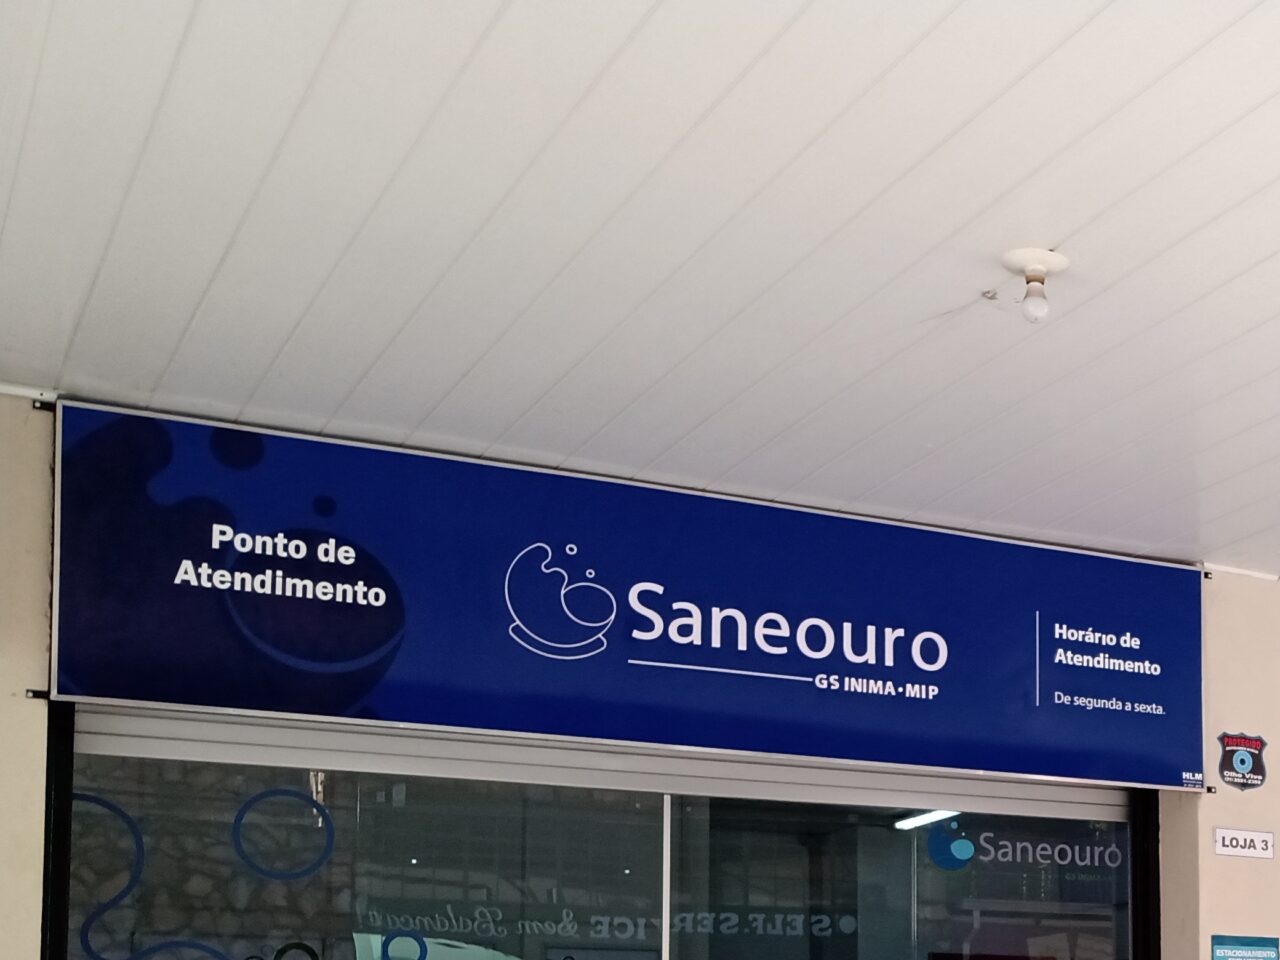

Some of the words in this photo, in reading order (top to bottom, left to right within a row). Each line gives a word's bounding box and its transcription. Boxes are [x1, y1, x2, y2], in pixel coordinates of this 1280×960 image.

[211, 523, 307, 559] Ponto
[317, 538, 356, 565] de
[174, 559, 386, 607] Atendimento
[628, 582, 948, 671] Saneouro
[1054, 623, 1116, 646] Horário
[1120, 632, 1140, 649] de
[1054, 648, 1161, 676] Atendimento
[814, 674, 840, 690] GS
[1054, 691, 1071, 705] De
[1073, 696, 1122, 710] segunda
[1124, 701, 1131, 711] a
[1134, 702, 1166, 715] sexta.
[1182, 771, 1203, 781] HLM
[979, 832, 1122, 868] Saneouro
[1221, 836, 1257, 850] LOJA
[1261, 839, 1269, 851] 3
[1215, 949, 1276, 959] ESTACIONAMENTO
